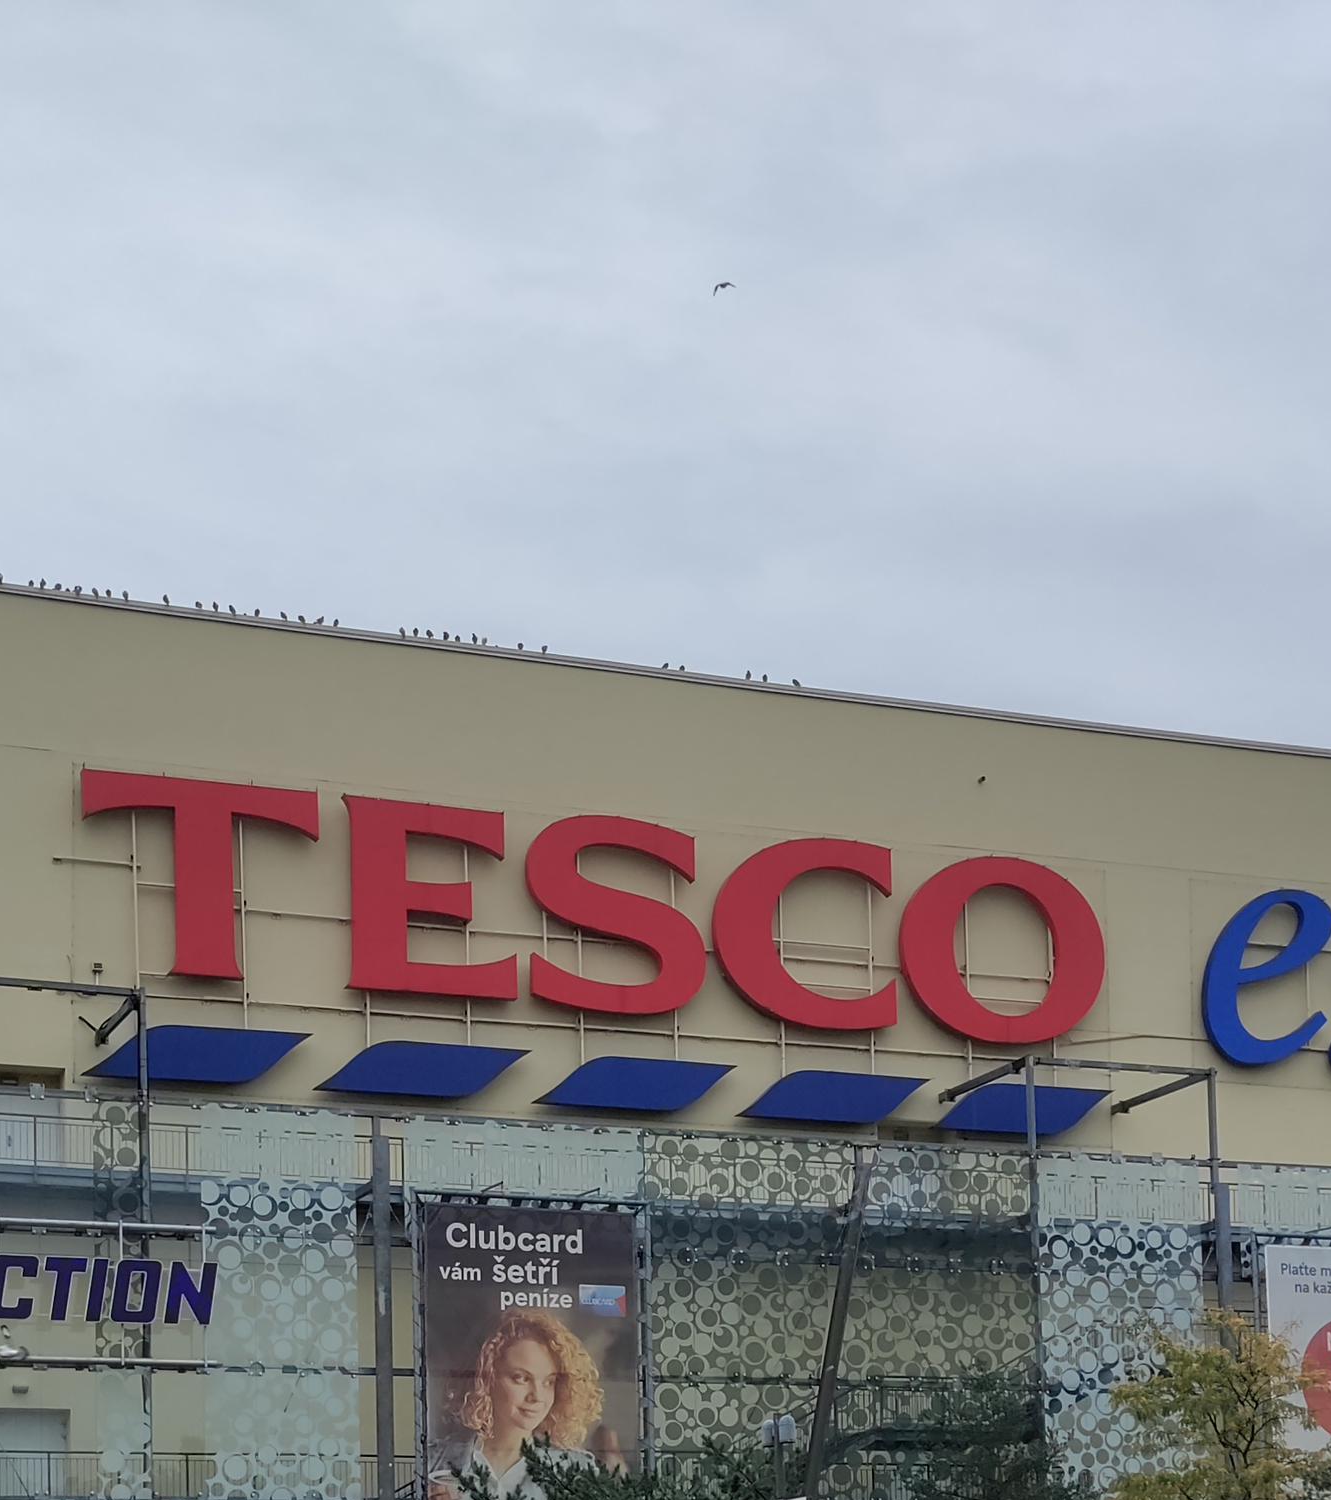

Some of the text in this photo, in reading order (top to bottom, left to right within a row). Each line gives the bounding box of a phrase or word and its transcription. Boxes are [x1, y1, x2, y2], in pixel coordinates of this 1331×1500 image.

[81, 767, 1105, 1045] TESCO
[445, 1222, 583, 1255] Clubcard
[439, 1255, 560, 1285] vám šetří
[1280, 1262, 1316, 1277] Plaťte
[500, 1288, 573, 1310] peníze
[1294, 1283, 1309, 1293] na
